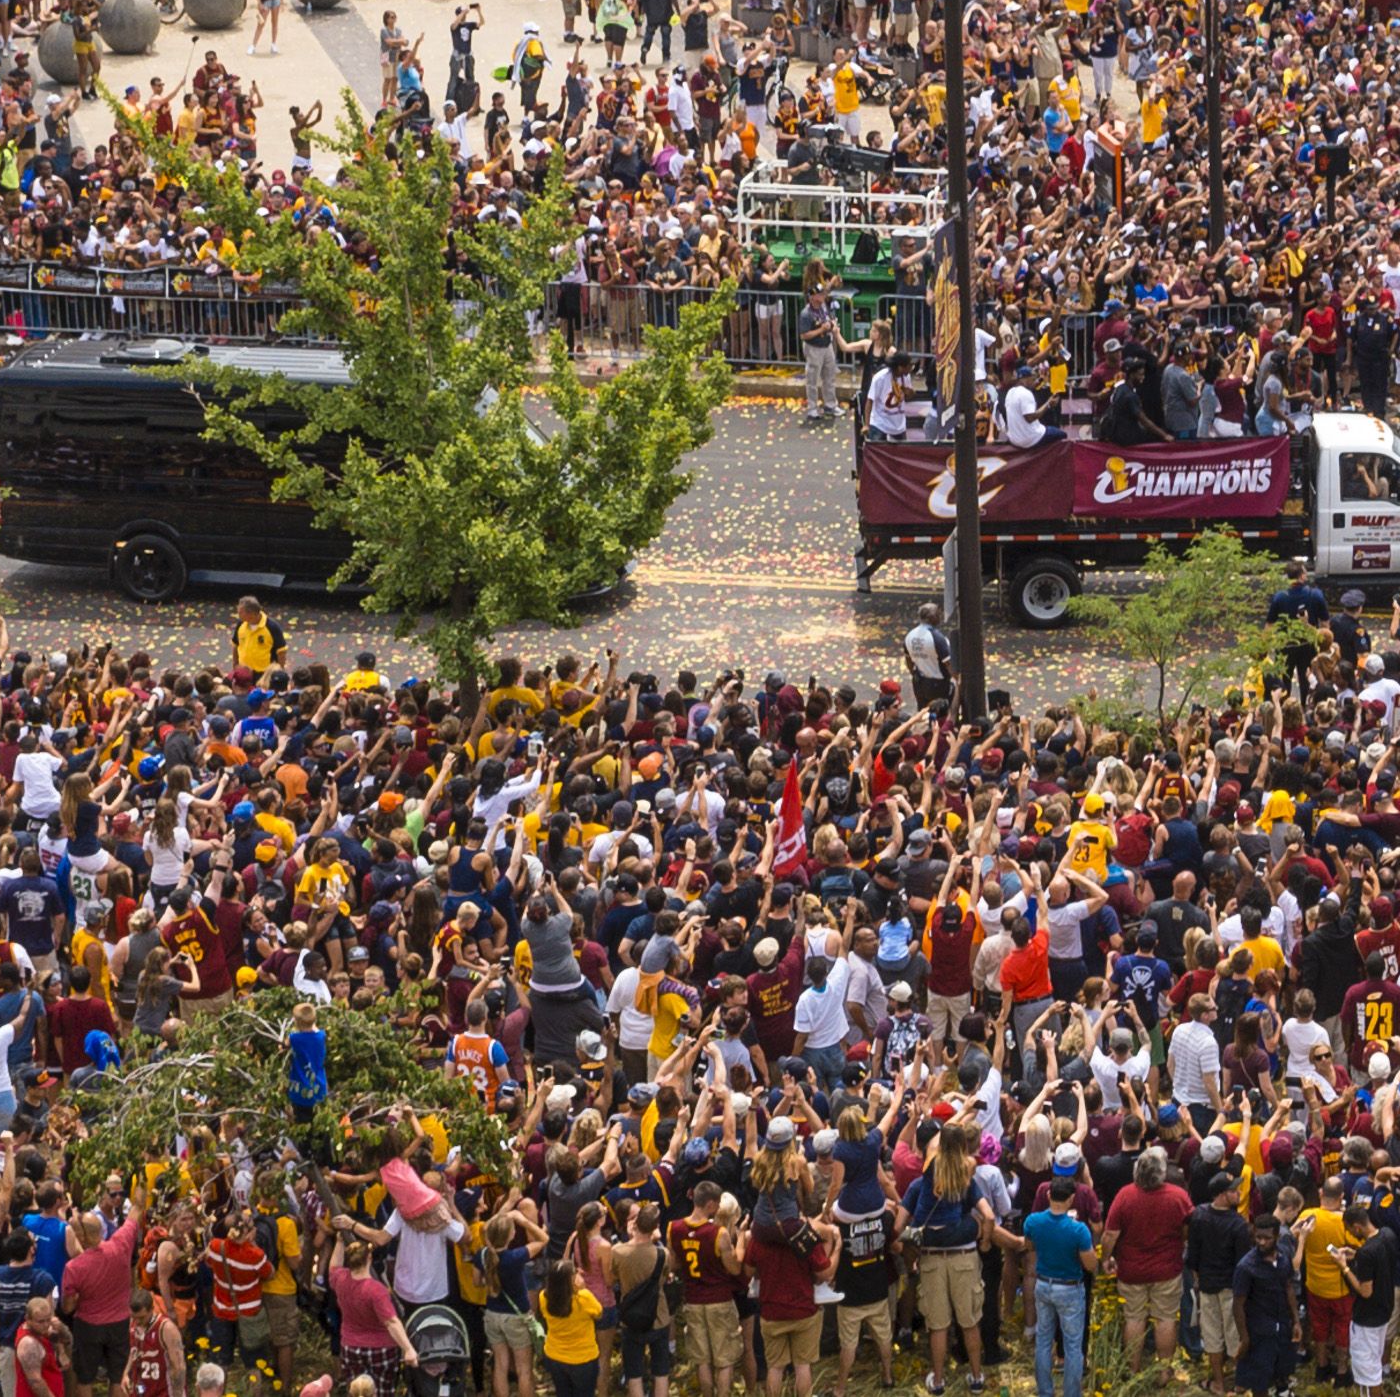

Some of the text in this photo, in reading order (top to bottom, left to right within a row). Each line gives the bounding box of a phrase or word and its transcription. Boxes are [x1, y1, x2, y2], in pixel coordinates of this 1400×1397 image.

[1253, 458, 1272, 468] NBA
[1093, 461, 1273, 504] CHAMPIONS
[1074, 845, 1090, 863] 23
[1365, 1001, 1393, 1041] 23
[684, 1248, 702, 1276] 2
[140, 1361, 161, 1381] 23
